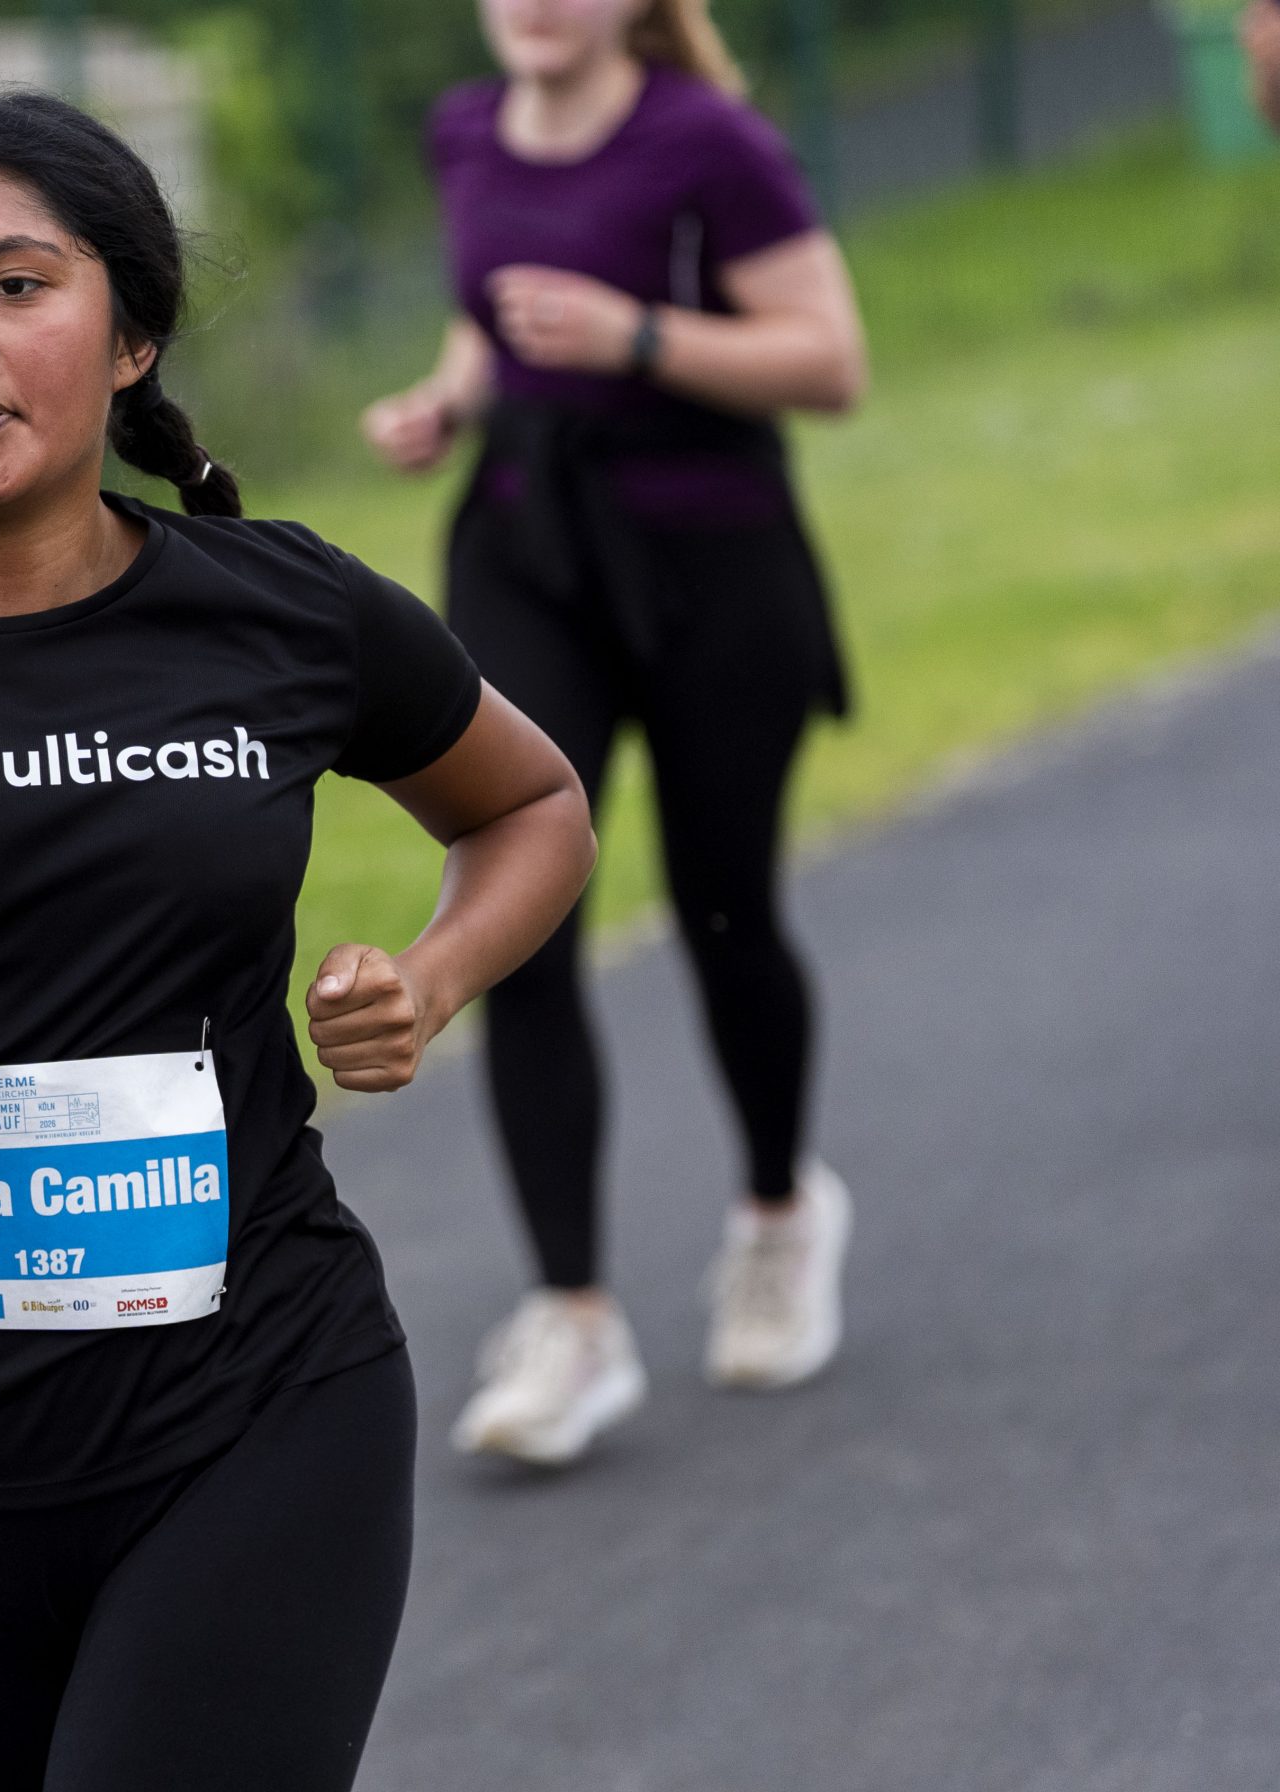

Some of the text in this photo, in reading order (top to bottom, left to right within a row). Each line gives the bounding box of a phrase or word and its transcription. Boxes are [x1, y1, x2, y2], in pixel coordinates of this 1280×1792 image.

[38, 1102, 56, 1111] KÖLN
[29, 1156, 222, 1217] Camilla
[14, 1248, 86, 1277] 1387
[117, 1298, 156, 1313] DKMS
